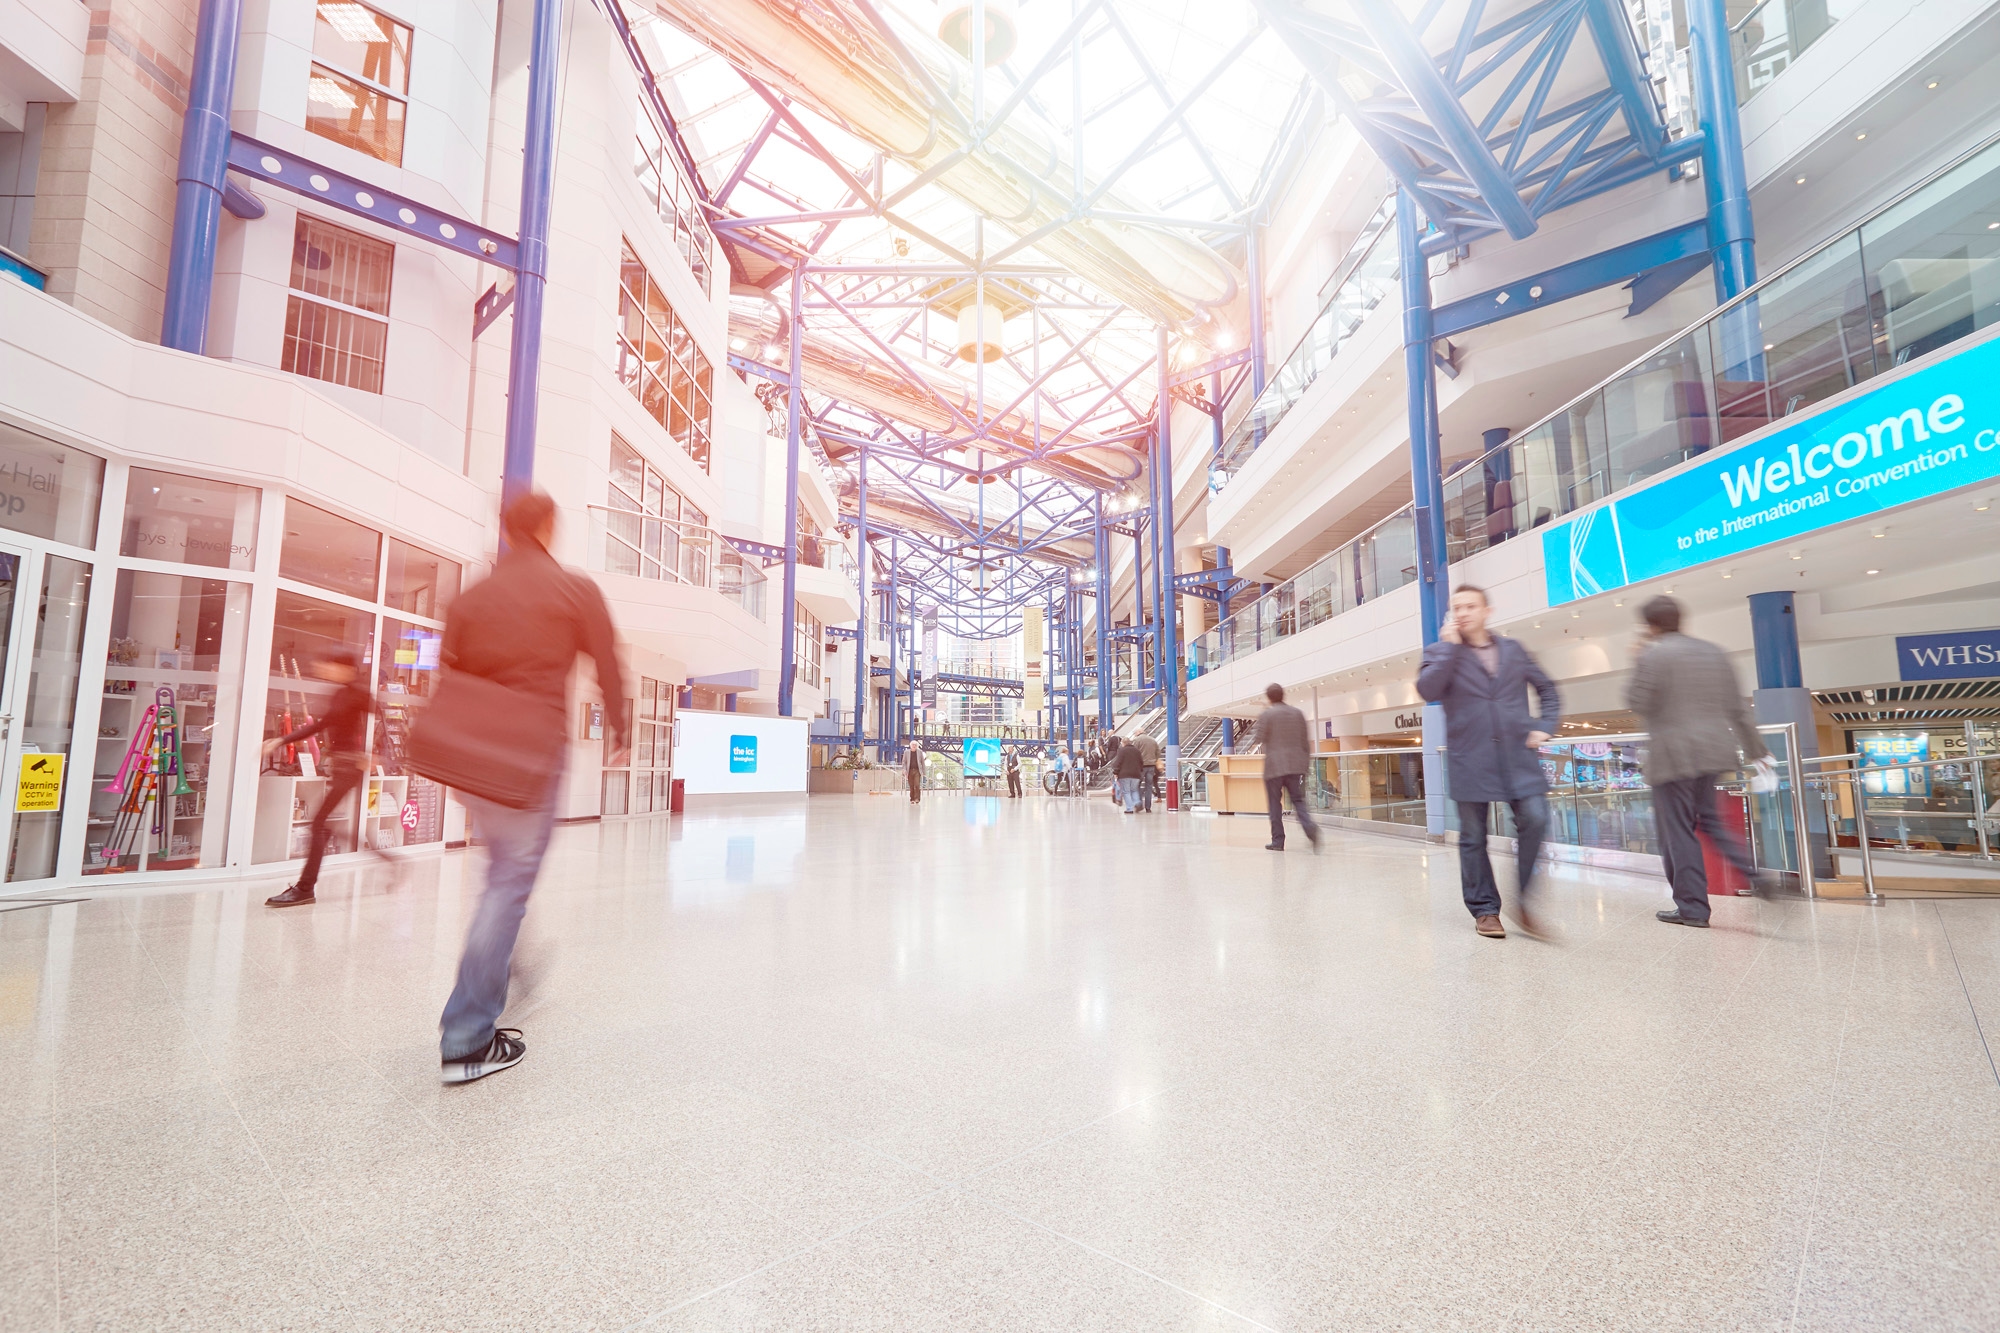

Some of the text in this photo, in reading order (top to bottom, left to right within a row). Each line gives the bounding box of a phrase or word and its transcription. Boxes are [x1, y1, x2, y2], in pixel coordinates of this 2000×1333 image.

[1720, 393, 1966, 509] Welcome
[13, 461, 56, 494] Hall
[1677, 536, 1692, 550] to
[1695, 525, 1719, 545] the
[1721, 485, 1830, 537] International
[1835, 443, 1968, 498] Convention
[180, 536, 253, 558] Jewellery
[925, 630, 935, 680] DISCOVER
[733, 746, 745, 755] the
[1863, 740, 1920, 753] FREE
[20, 781, 59, 791] Warning
[21, 800, 54, 808] operation
